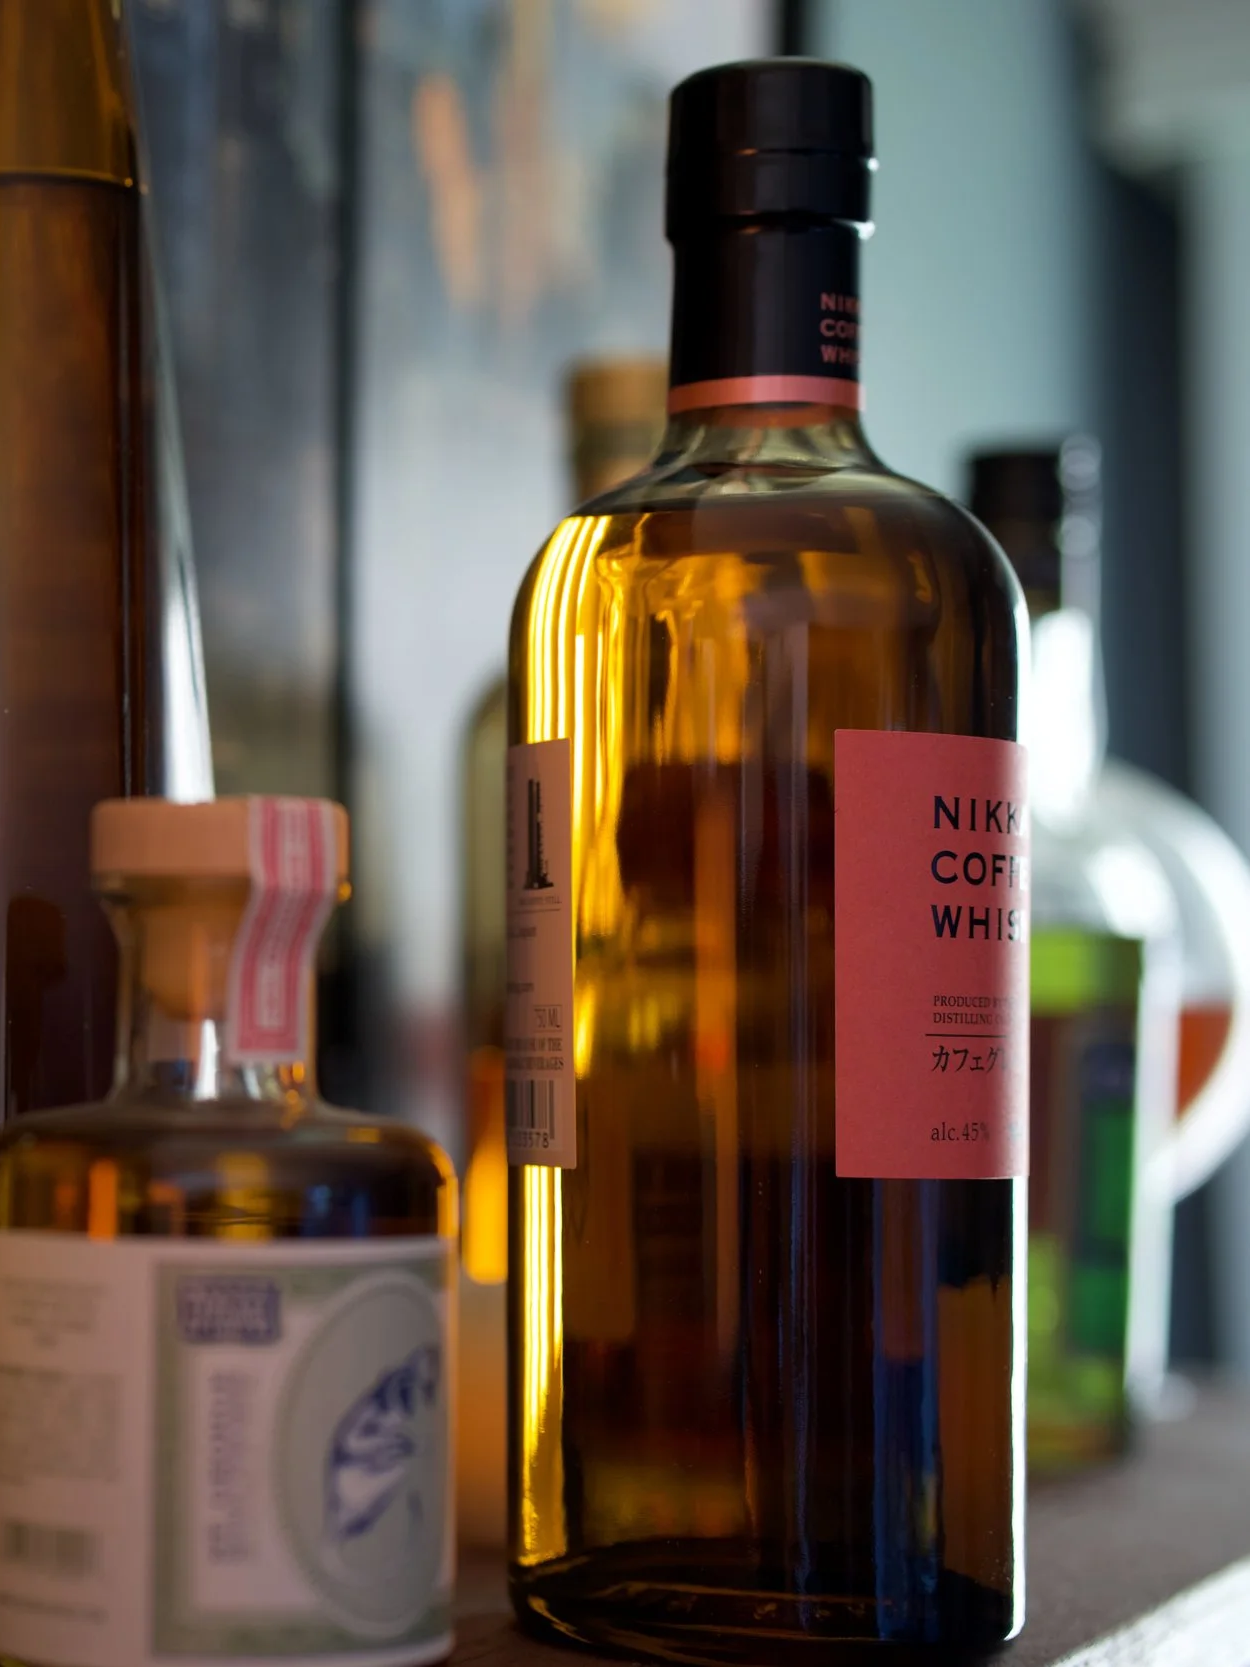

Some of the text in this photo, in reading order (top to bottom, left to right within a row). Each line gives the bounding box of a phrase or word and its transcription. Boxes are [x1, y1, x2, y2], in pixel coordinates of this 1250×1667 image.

[820, 292, 859, 314] NI
[820, 344, 859, 365] WH
[931, 850, 1026, 890] COFF
[931, 904, 1026, 943] WHIS
[933, 995, 990, 1008] PRODUCED
[933, 1012, 993, 1025] DISTILLING
